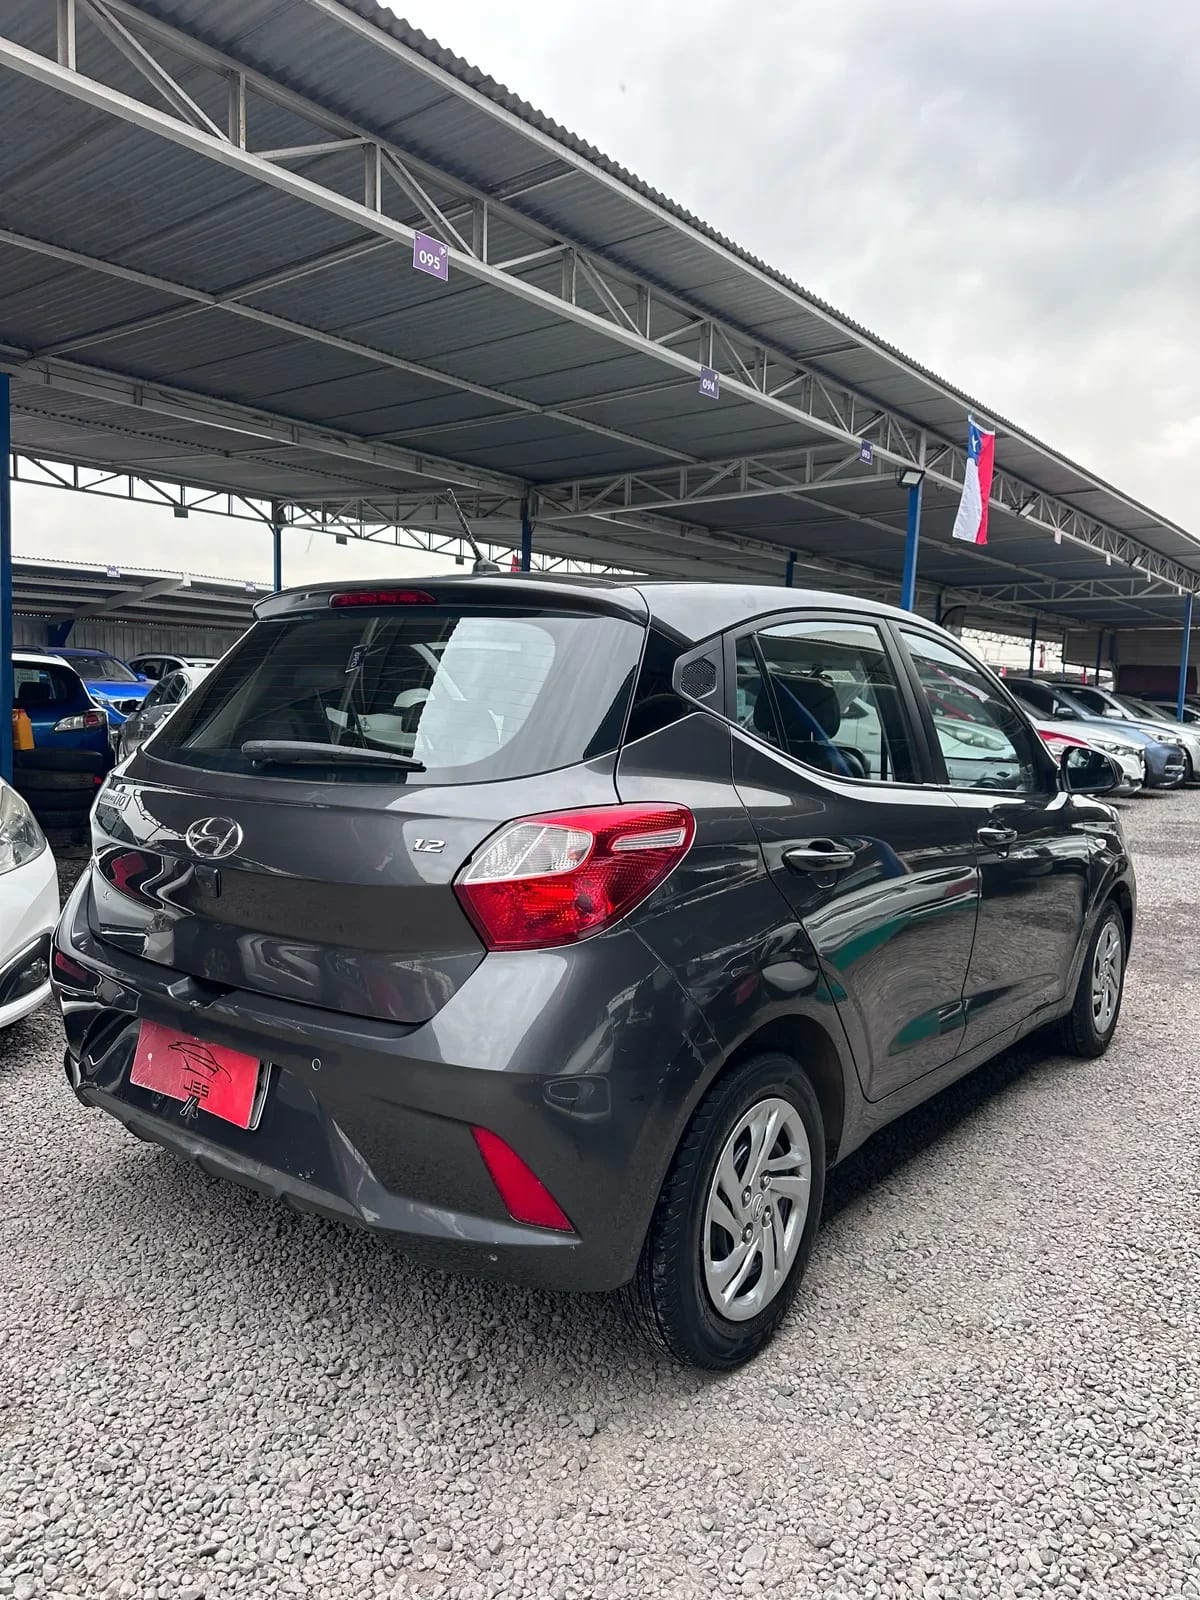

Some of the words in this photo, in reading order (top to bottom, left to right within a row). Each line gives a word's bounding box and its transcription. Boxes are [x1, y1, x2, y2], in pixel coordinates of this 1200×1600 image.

[419, 250, 440, 270] 095
[702, 378, 715, 392] 094
[183, 1079, 210, 1098] JES
